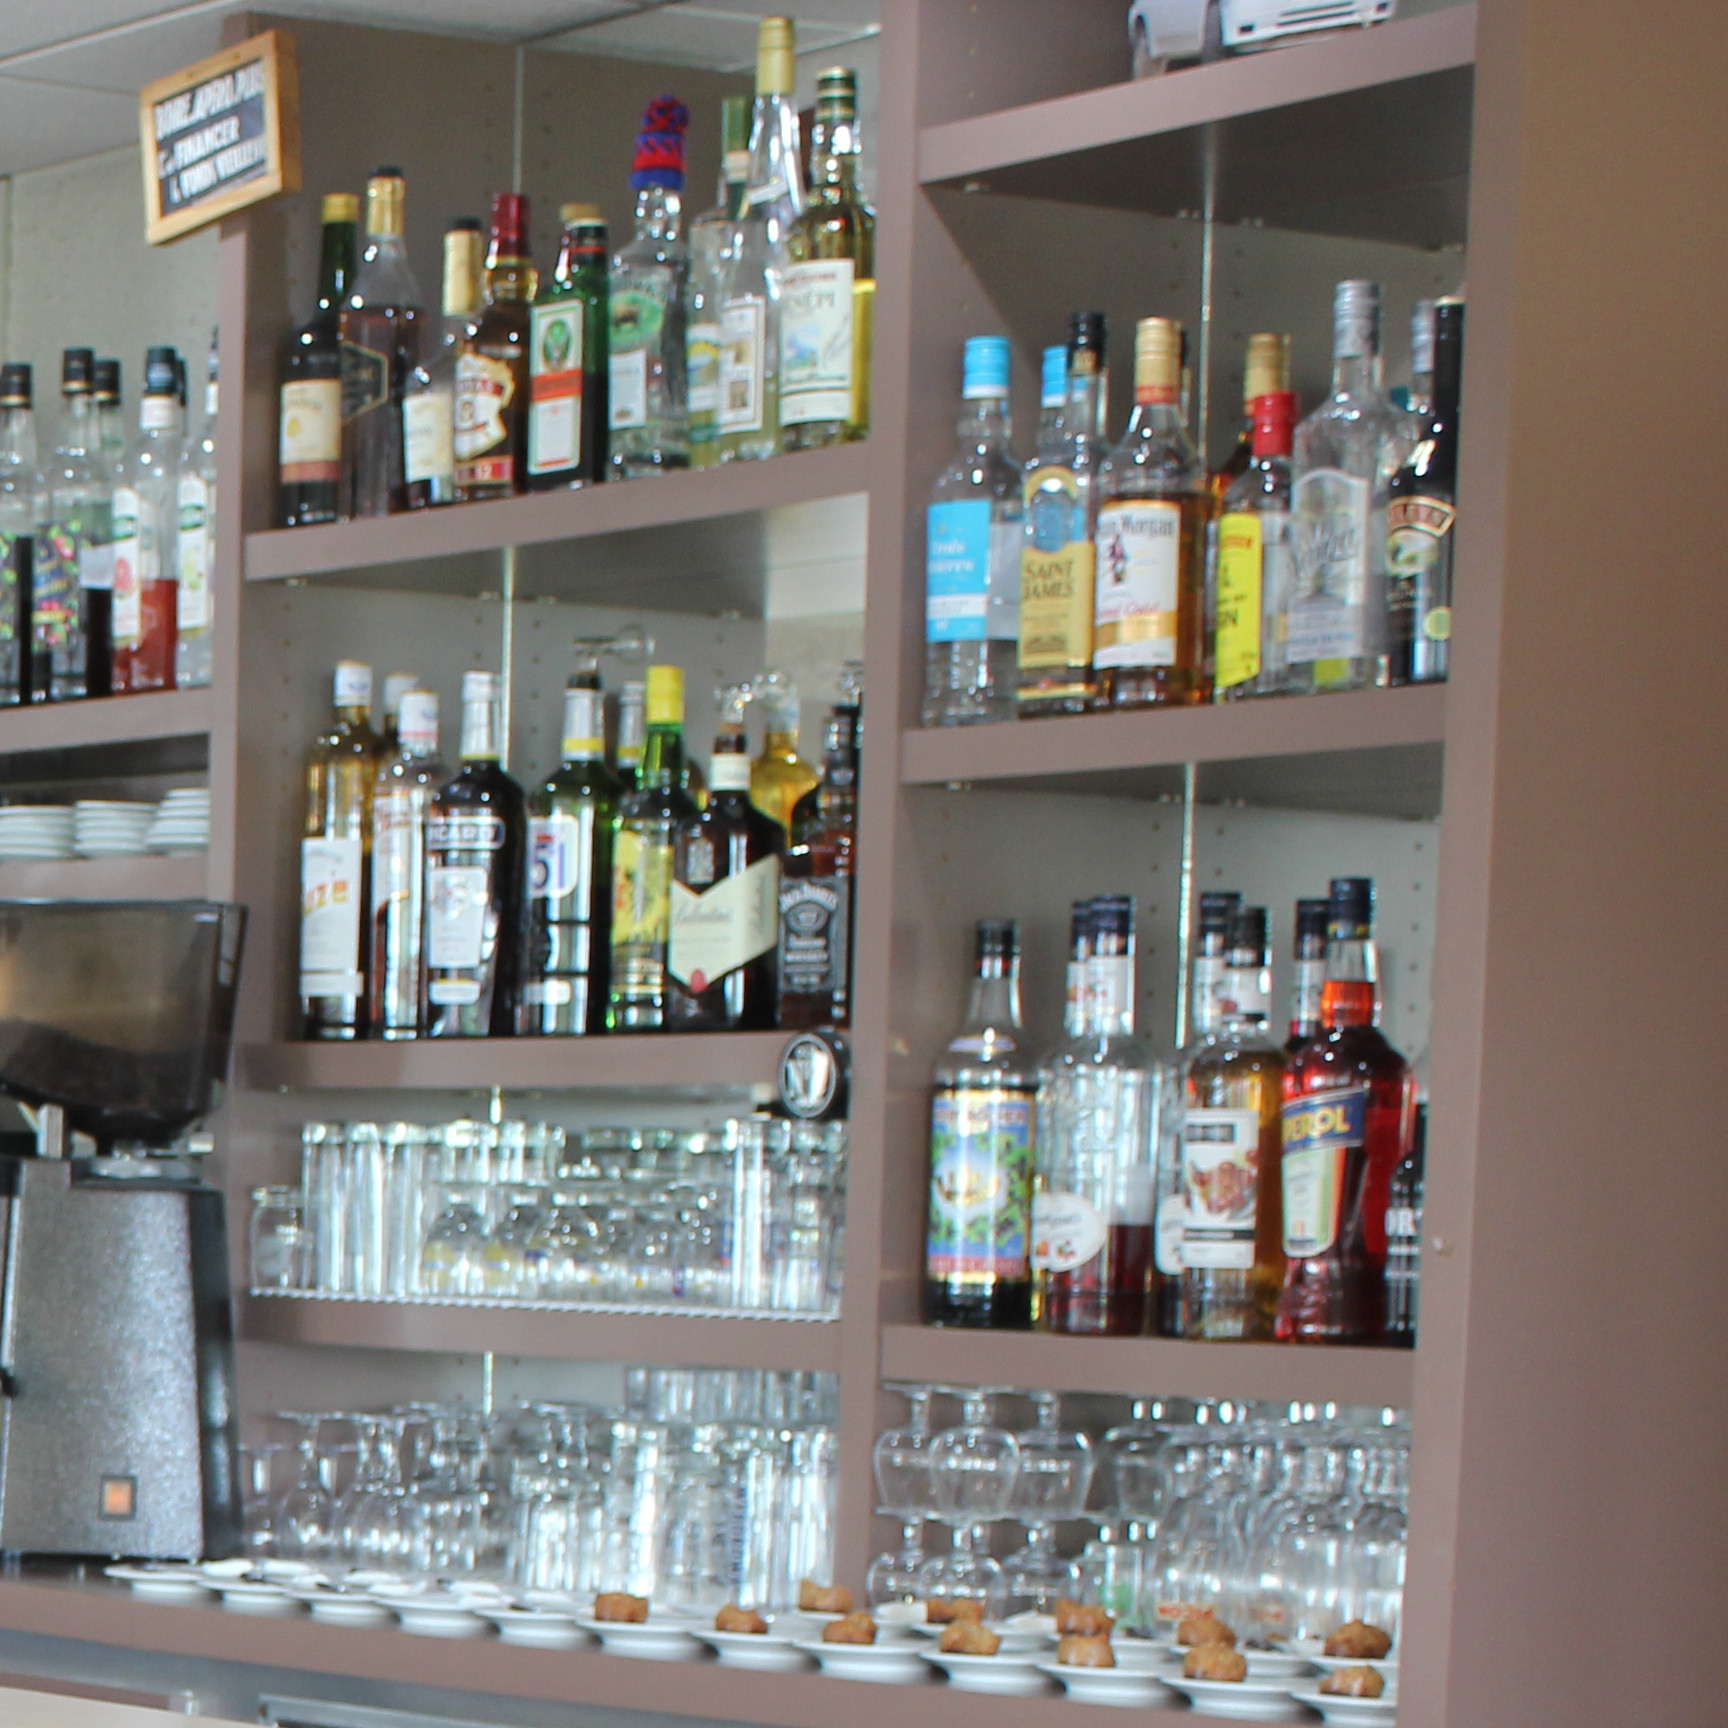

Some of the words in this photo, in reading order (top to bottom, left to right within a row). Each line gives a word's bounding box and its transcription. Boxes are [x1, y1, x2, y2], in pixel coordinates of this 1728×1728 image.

[1023, 560, 1073, 579] SAINT
[1024, 581, 1074, 600] JAMES
[1283, 1107, 1350, 1143] PEROL
